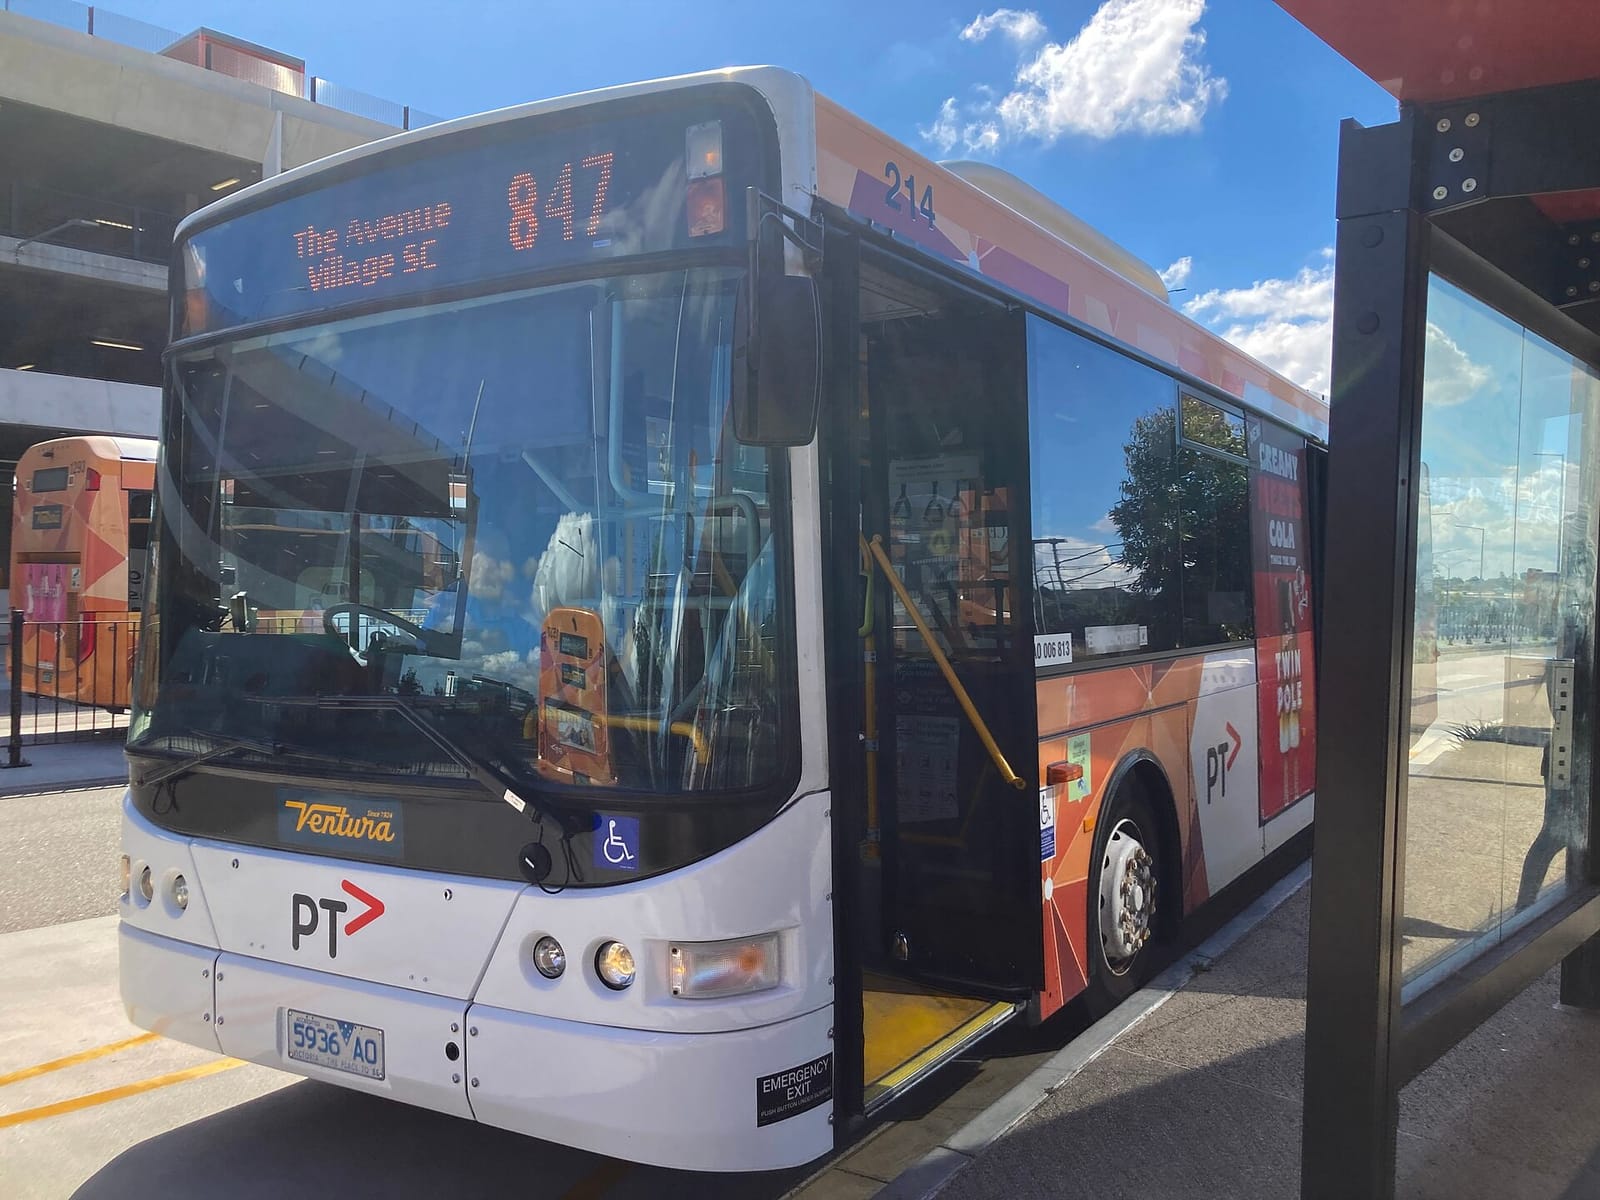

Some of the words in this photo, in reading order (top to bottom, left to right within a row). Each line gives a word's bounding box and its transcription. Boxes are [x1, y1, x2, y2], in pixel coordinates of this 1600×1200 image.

[508, 152, 614, 251] 847
[884, 161, 936, 230] 214
[293, 225, 339, 259] The
[346, 202, 452, 248] Avenue
[308, 254, 395, 292] Village
[402, 239, 437, 273] SC
[1258, 442, 1298, 481] CREAMY
[1269, 519, 1296, 549] COLA
[1043, 642, 1056, 659] 006
[1058, 641, 1070, 657] 813
[1275, 649, 1302, 681] TWIN
[1277, 681, 1303, 713] POLE
[1207, 742, 1229, 804] PT
[284, 800, 395, 842] Ventura
[292, 893, 348, 959] PT
[293, 1022, 340, 1057] 5936
[763, 1058, 829, 1093] EMERGENCY
[787, 1080, 812, 1100] EXIT
[777, 1101, 798, 1113] BUTTON
